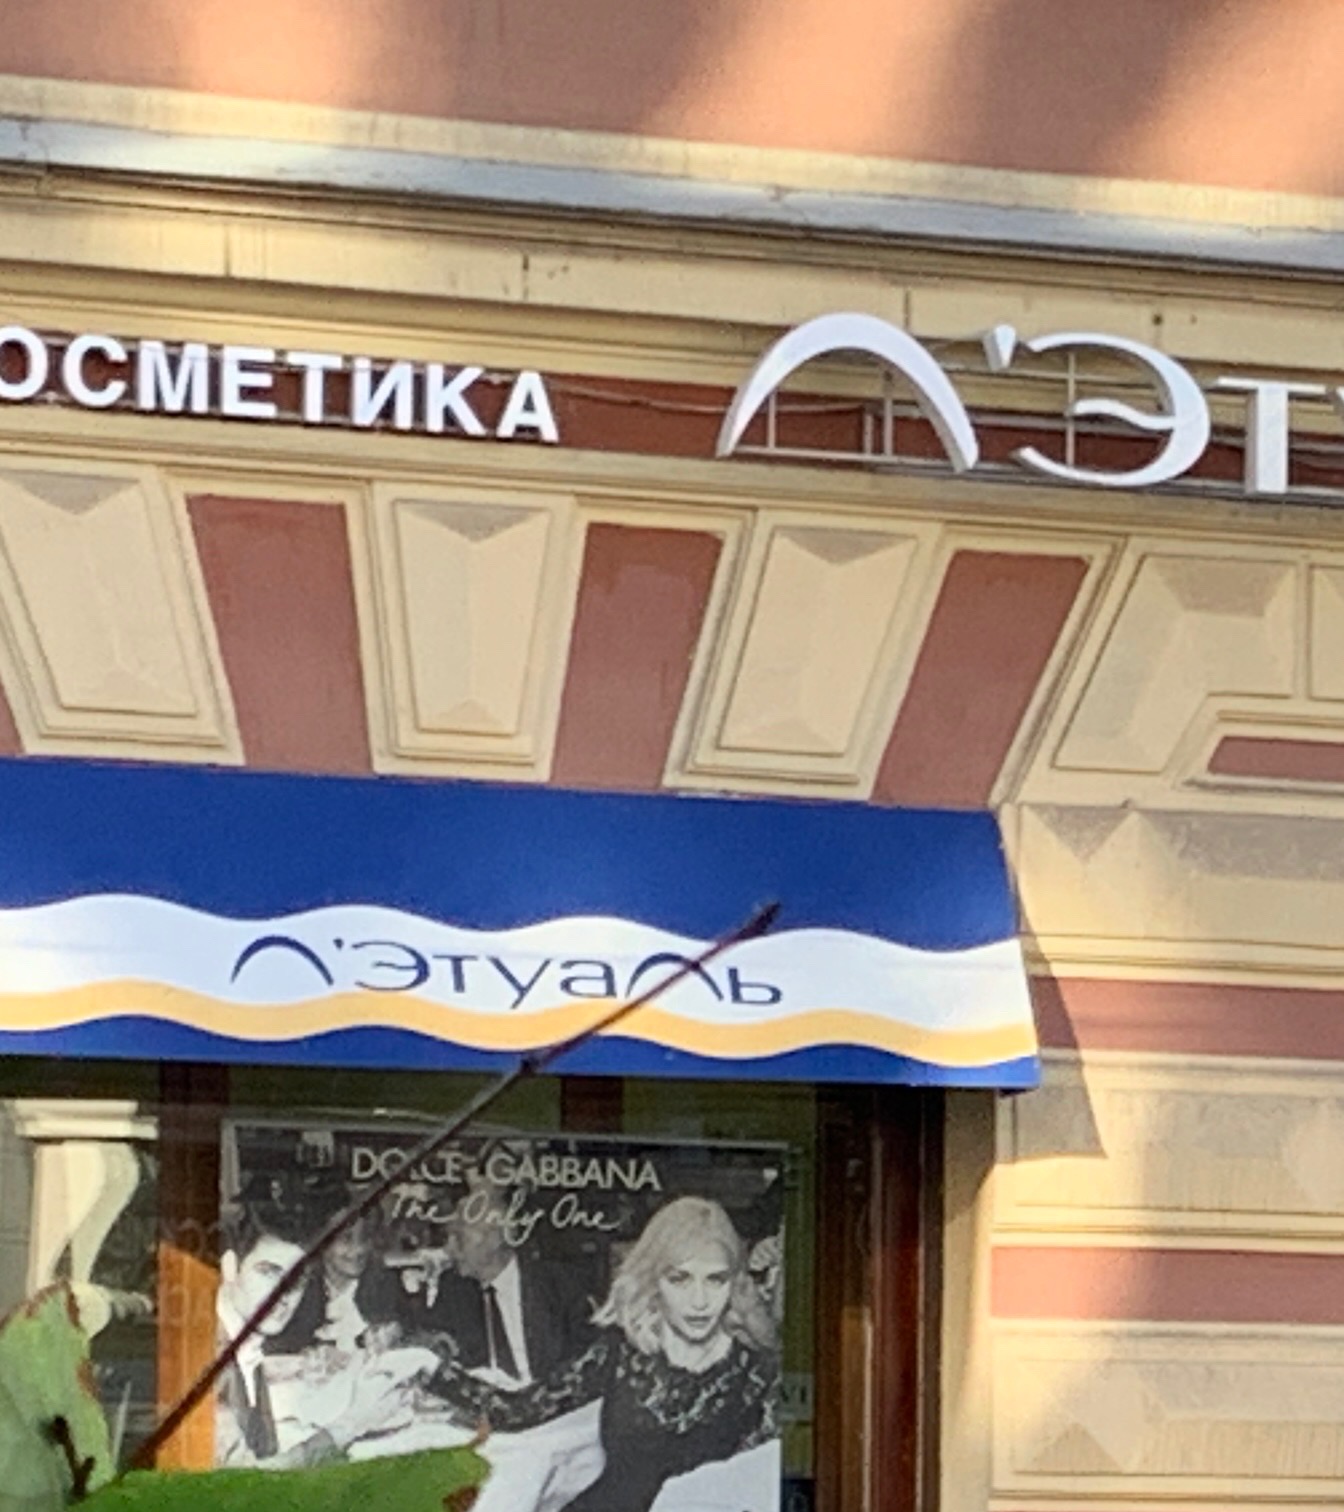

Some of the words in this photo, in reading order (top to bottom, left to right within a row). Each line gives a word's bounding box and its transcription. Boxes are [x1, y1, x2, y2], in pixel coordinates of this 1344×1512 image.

[0, 325, 560, 443] ОСМЕТИКА
[485, 1150, 662, 1191] GABBANA
[389, 1192, 461, 1225] The
[462, 1190, 544, 1247] Only
[551, 1193, 622, 1231] One
